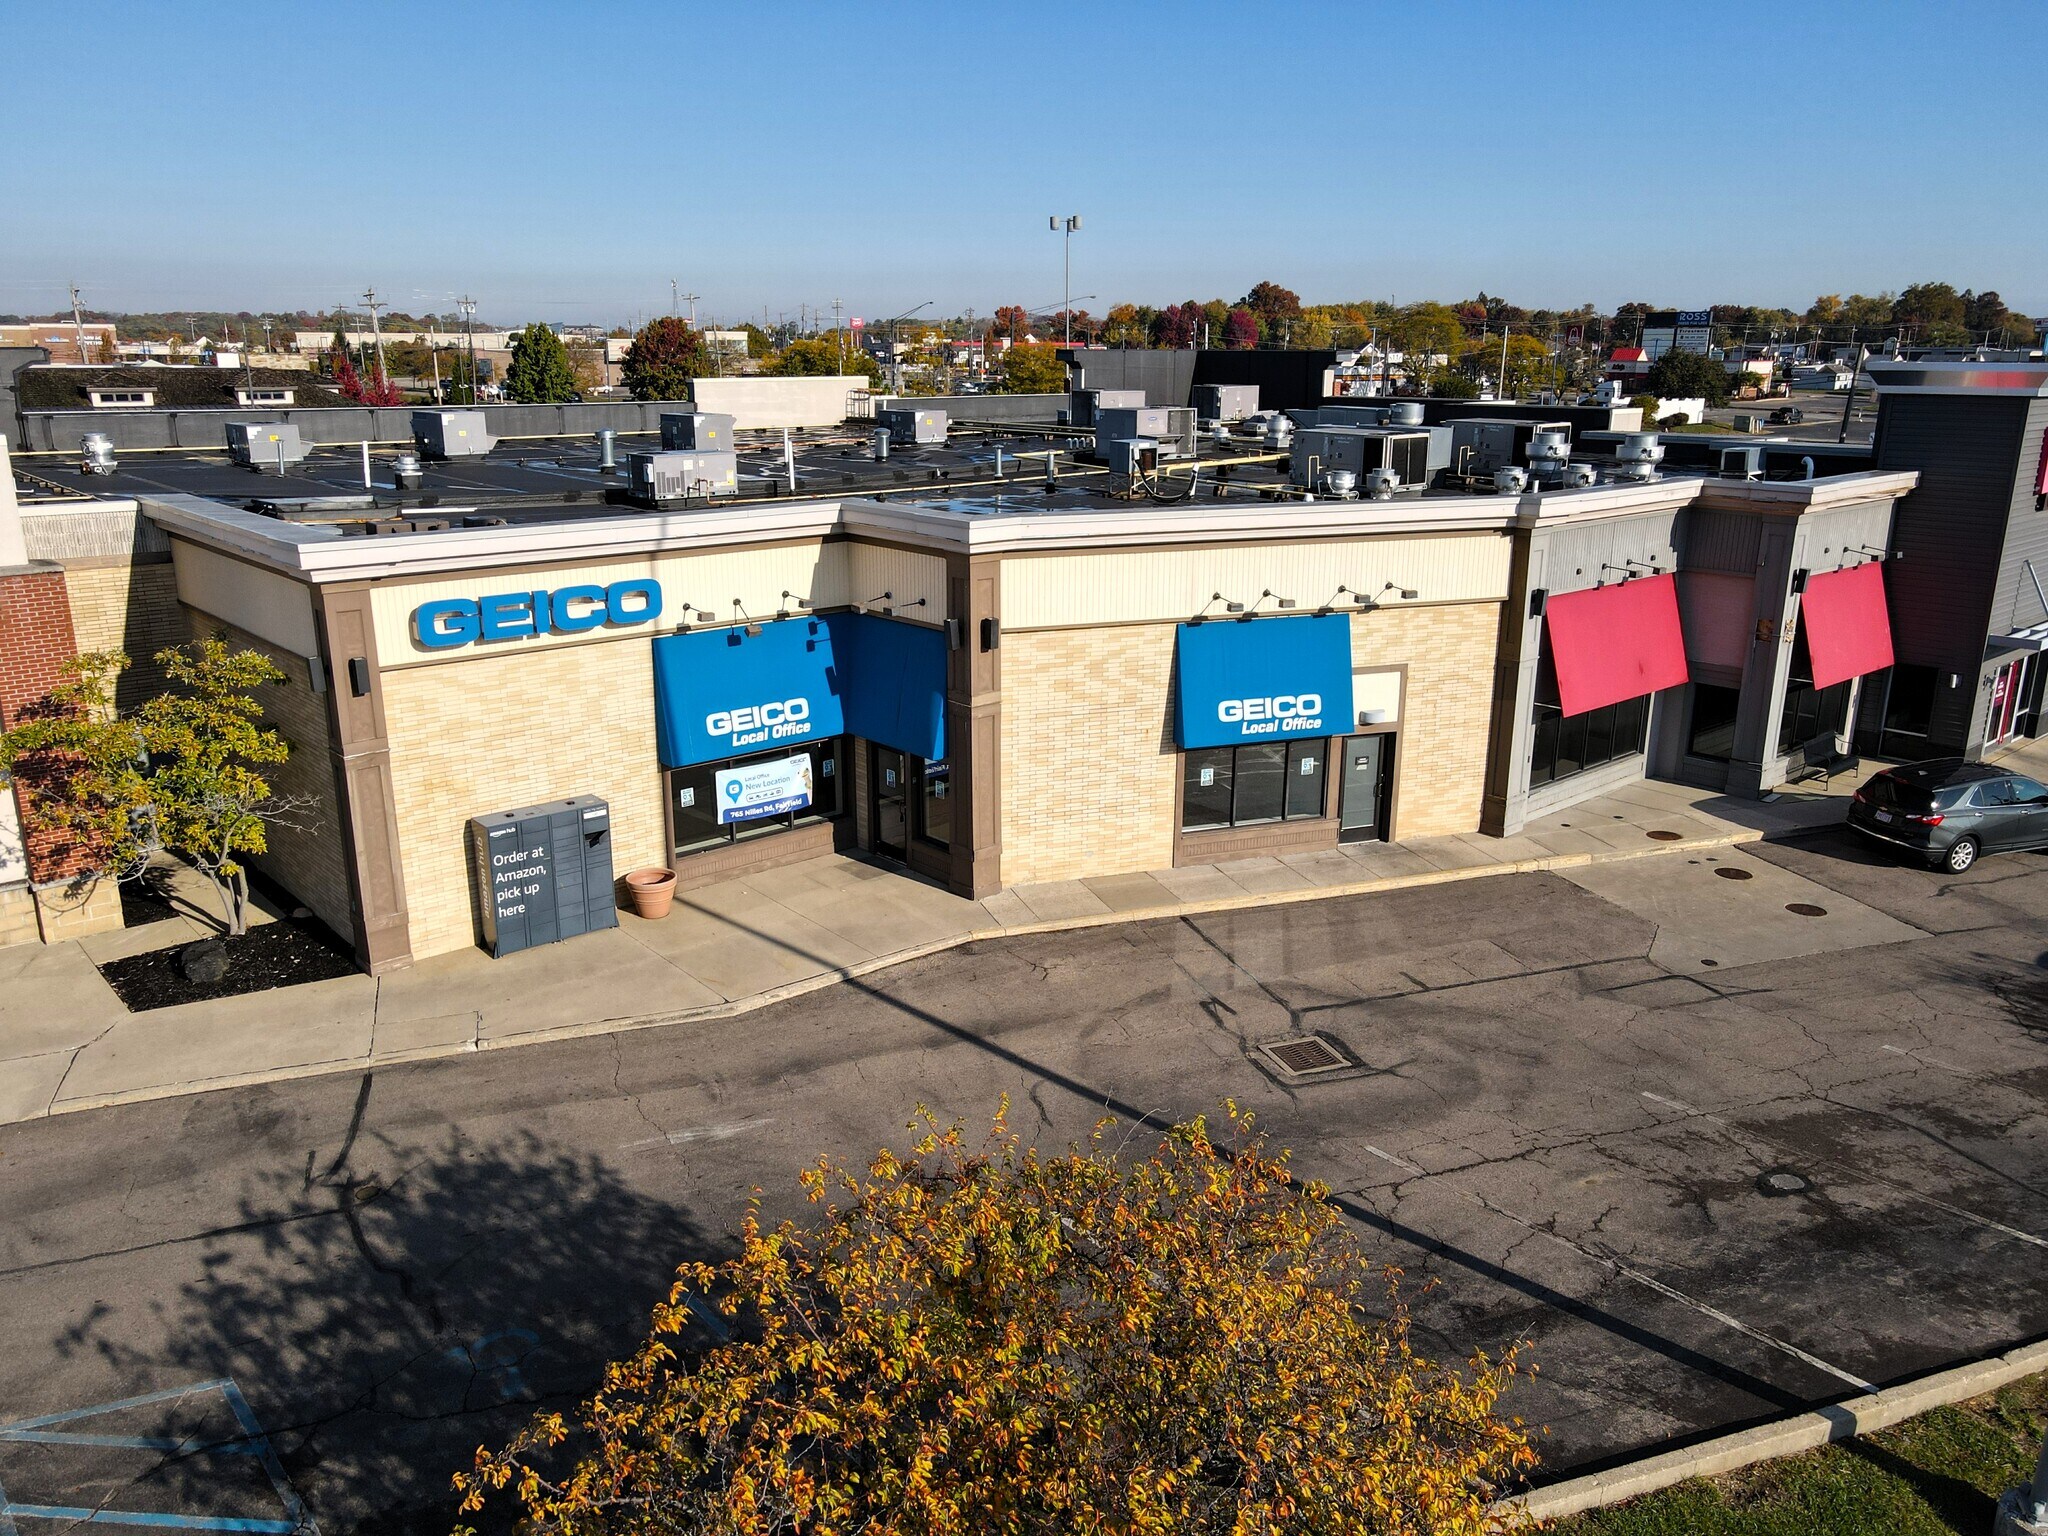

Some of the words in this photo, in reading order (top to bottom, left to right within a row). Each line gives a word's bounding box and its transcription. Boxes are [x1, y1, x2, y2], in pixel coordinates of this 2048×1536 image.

[1679, 312, 1708, 321] ROSS
[414, 578, 663, 648] GEICO
[705, 697, 810, 737] GEICO
[1217, 693, 1322, 723] GEICO
[732, 727, 769, 747] Local
[771, 721, 811, 739] Office
[1241, 718, 1278, 735] Local
[1281, 717, 1323, 731] Office
[745, 782, 762, 790] New
[762, 775, 791, 787] Location
[757, 772, 770, 780] Office
[730, 810, 744, 818] 765
[744, 808, 764, 816] Nilles
[775, 798, 803, 812] Fairfield
[506, 826, 516, 834] hub
[476, 835, 487, 866] hub
[493, 850, 529, 867] Order
[531, 845, 545, 858] at
[495, 864, 547, 885] Amazon,
[480, 867, 490, 919] amazon
[496, 886, 522, 904] pick
[524, 883, 540, 898] up
[498, 903, 526, 918] here
